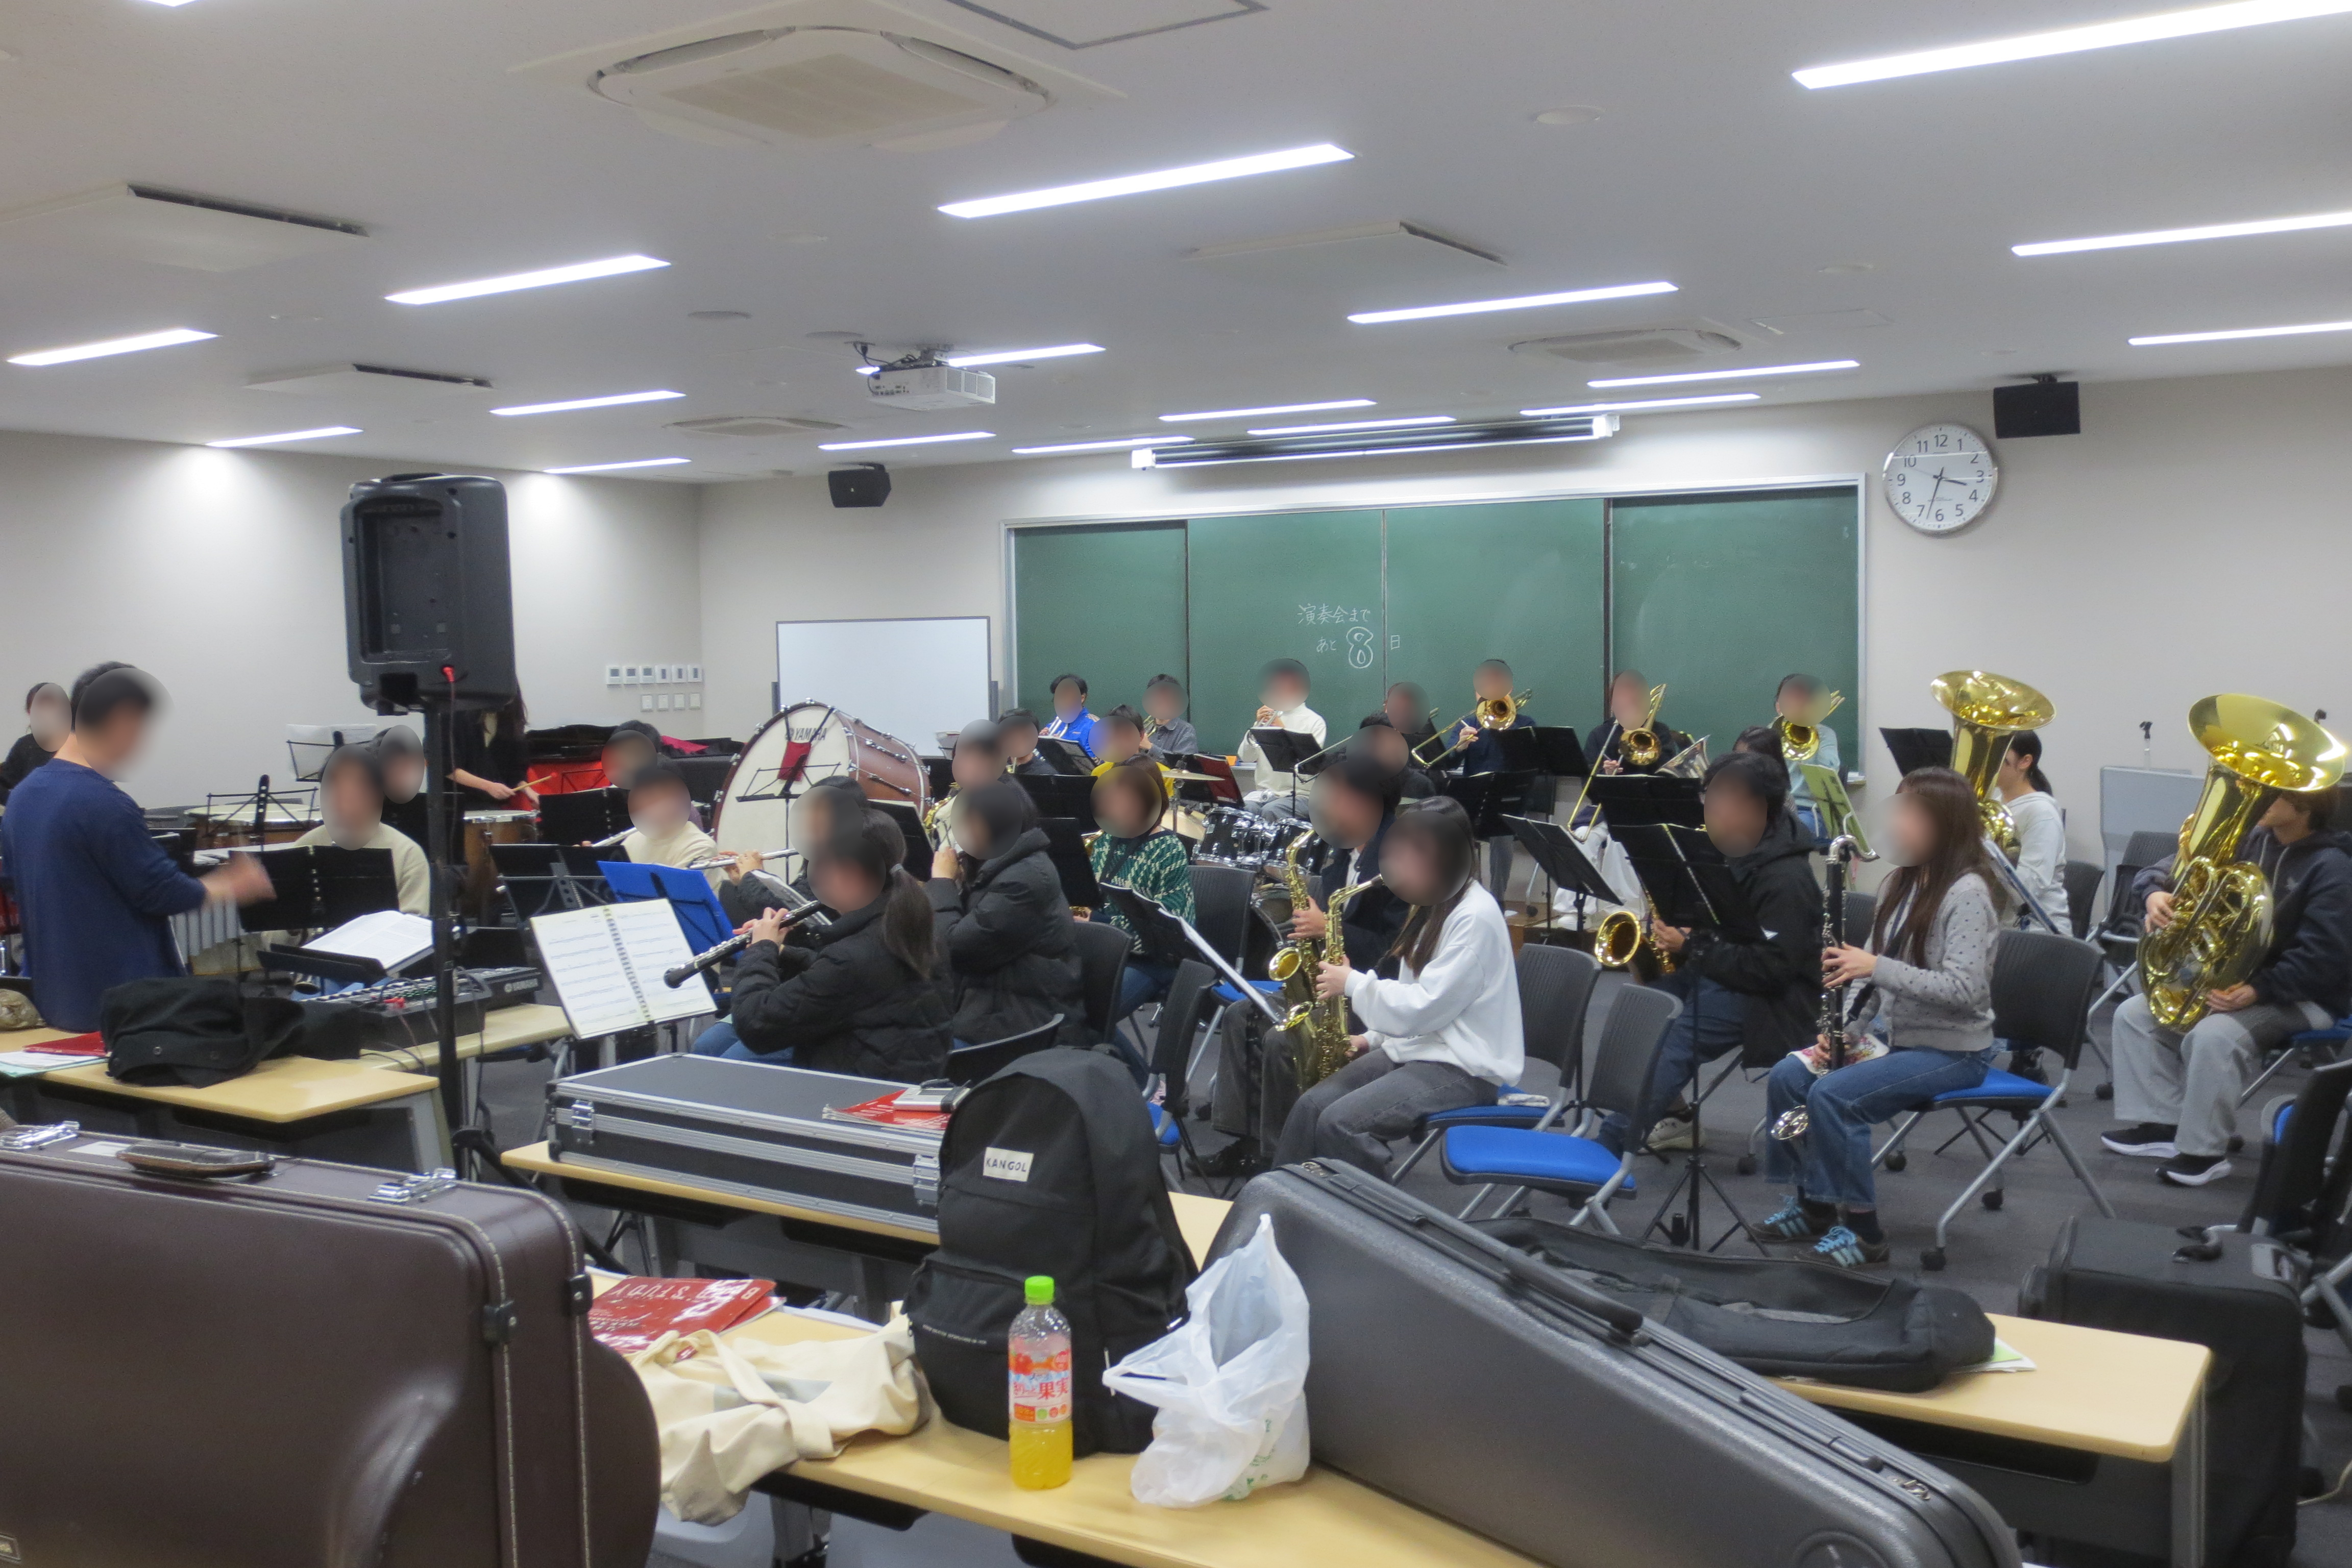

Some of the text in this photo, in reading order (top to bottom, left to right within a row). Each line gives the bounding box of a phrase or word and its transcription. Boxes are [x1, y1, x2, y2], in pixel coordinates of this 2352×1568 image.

[1917, 440, 1928, 453] 11
[1934, 434, 1948, 447] 12
[1957, 438, 1963, 451] 1
[1904, 455, 1917, 468] 10
[1970, 453, 1979, 464] 2
[1897, 473, 1906, 486] 9
[1976, 470, 1984, 483] 3
[1902, 492, 1912, 504] 8
[1969, 489, 1978, 503] 4
[1916, 504, 1925, 518] 7
[1935, 509, 1944, 522] 6
[1955, 504, 1964, 517] 5
[1297, 602, 1370, 626] 演奏会まで
[1316, 626, 1401, 669] あと 8 日
[985, 1157, 1027, 1172] KANGOL
